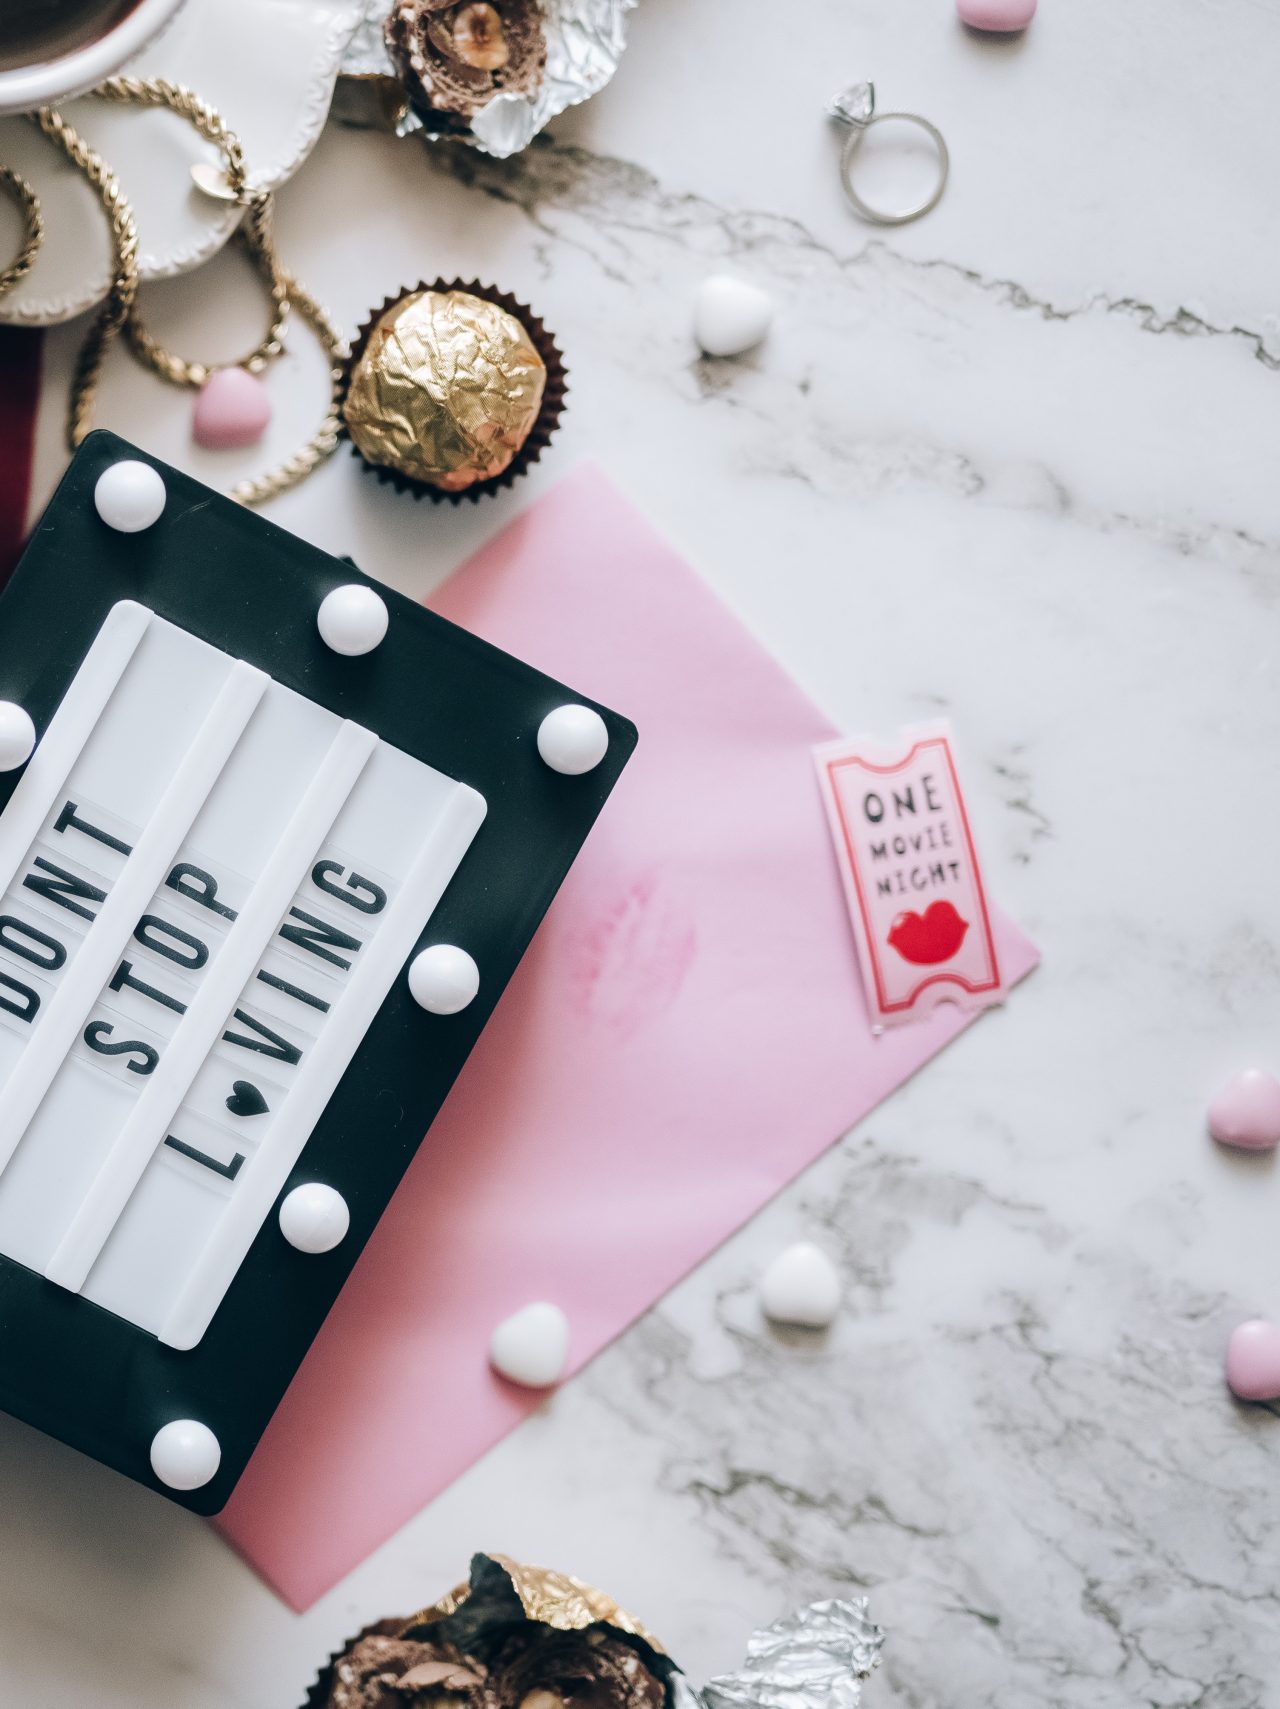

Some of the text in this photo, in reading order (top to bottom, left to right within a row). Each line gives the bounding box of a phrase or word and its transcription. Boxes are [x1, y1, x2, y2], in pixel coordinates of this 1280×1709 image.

[863, 773, 942, 824] ONE
[871, 822, 953, 860] MOVIE
[877, 862, 960, 896] NIGHT
[83, 862, 238, 1076] STOP
